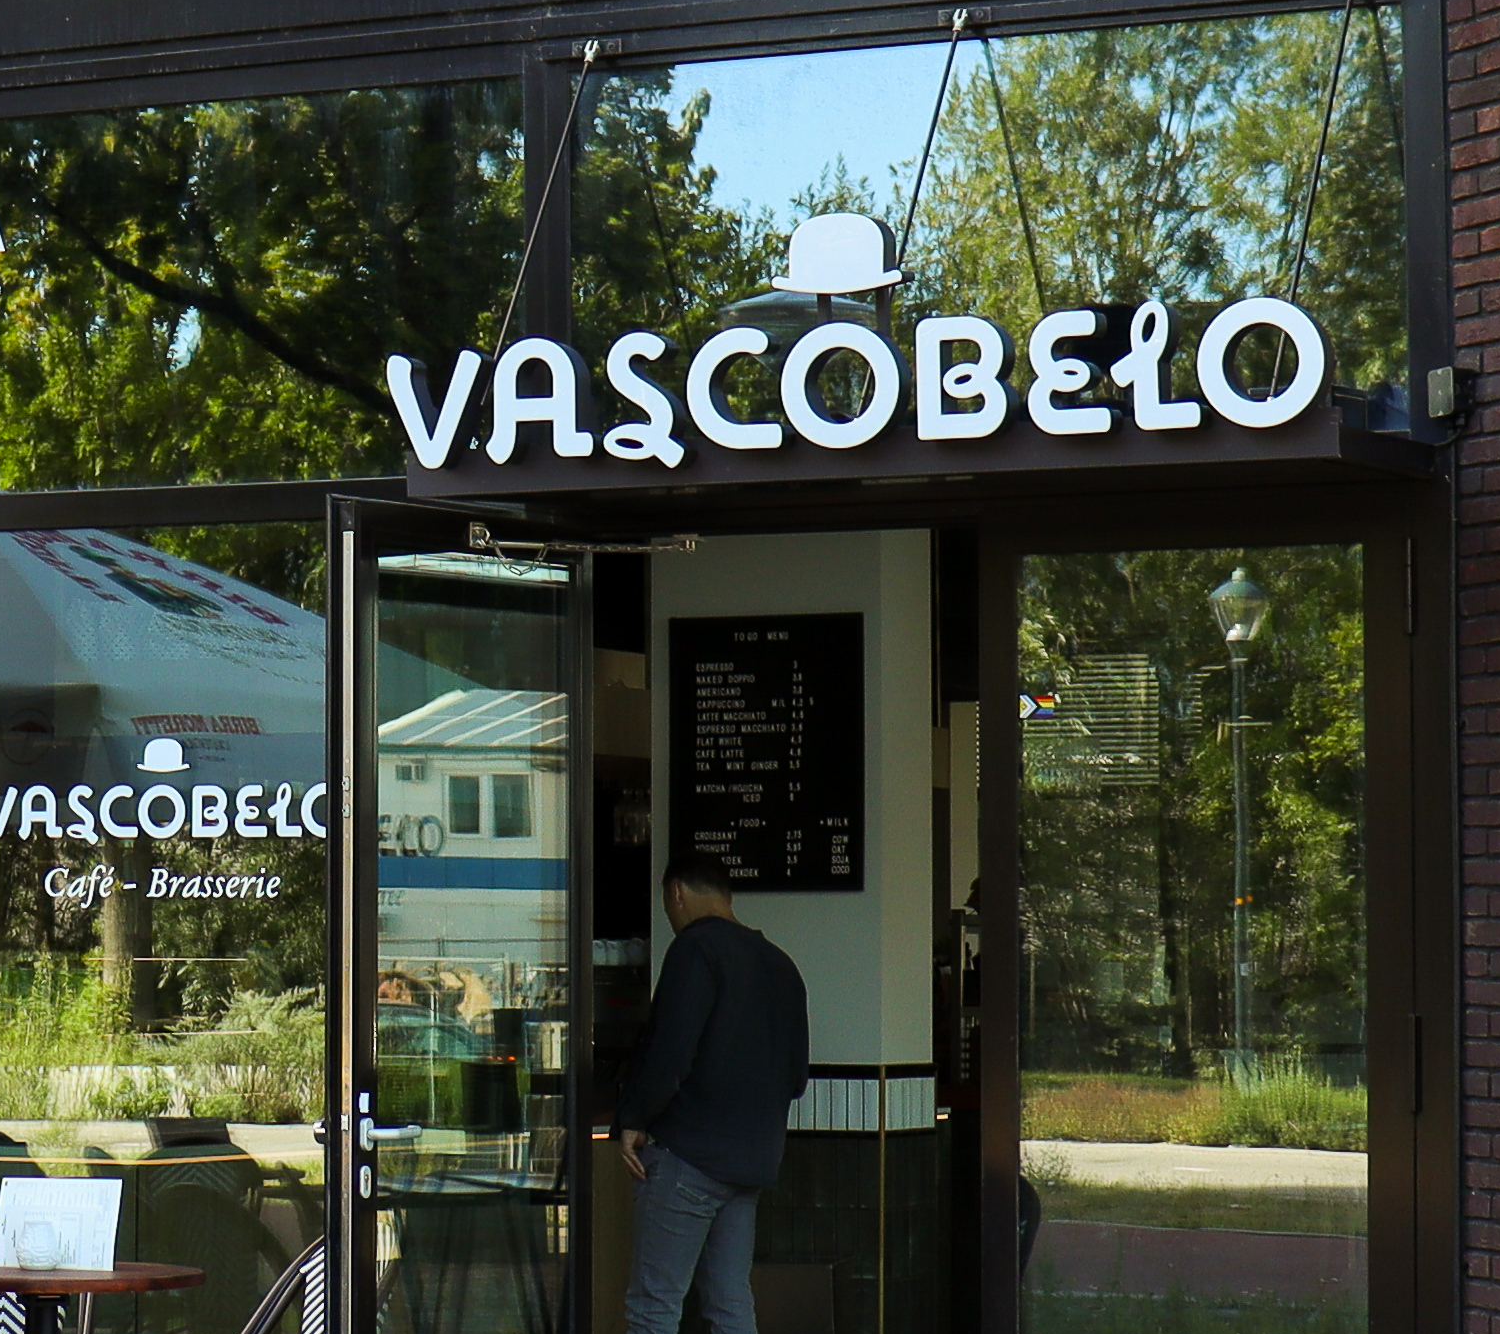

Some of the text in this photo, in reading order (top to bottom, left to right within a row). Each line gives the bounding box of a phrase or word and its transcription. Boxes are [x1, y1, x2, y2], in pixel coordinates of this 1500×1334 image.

[385, 295, 1328, 470] VASCOBELO
[767, 631, 789, 640] MENU
[696, 662, 734, 672] ESPRESSO
[696, 675, 723, 685] NAKED
[728, 674, 755, 683] DOPPIO
[696, 687, 741, 697] AMERICANO
[697, 699, 745, 709] CAPPUCCINO
[697, 713, 719, 722] LATTE
[723, 712, 766, 721] MACCHIATO
[697, 725, 736, 734] ESPRESSO
[741, 724, 786, 733] MACCHIATO
[696, 737, 714, 746] FLAT
[718, 736, 742, 746] WHITE
[696, 750, 715, 758] CAFE
[720, 749, 744, 758] LATTE
[696, 762, 710, 771] TEA
[726, 761, 744, 771] MINT
[751, 761, 778, 770] GINGER
[696, 784, 725, 793] MATCHA
[743, 794, 761, 802] ICED
[739, 818, 849, 827] FOOD MILK
[695, 831, 737, 840] CROISSANT
[832, 835, 849, 844] COW
[832, 845, 845, 854] OAT
[831, 856, 849, 864] SOJA
[44, 864, 281, 909] Café - Brasserie
